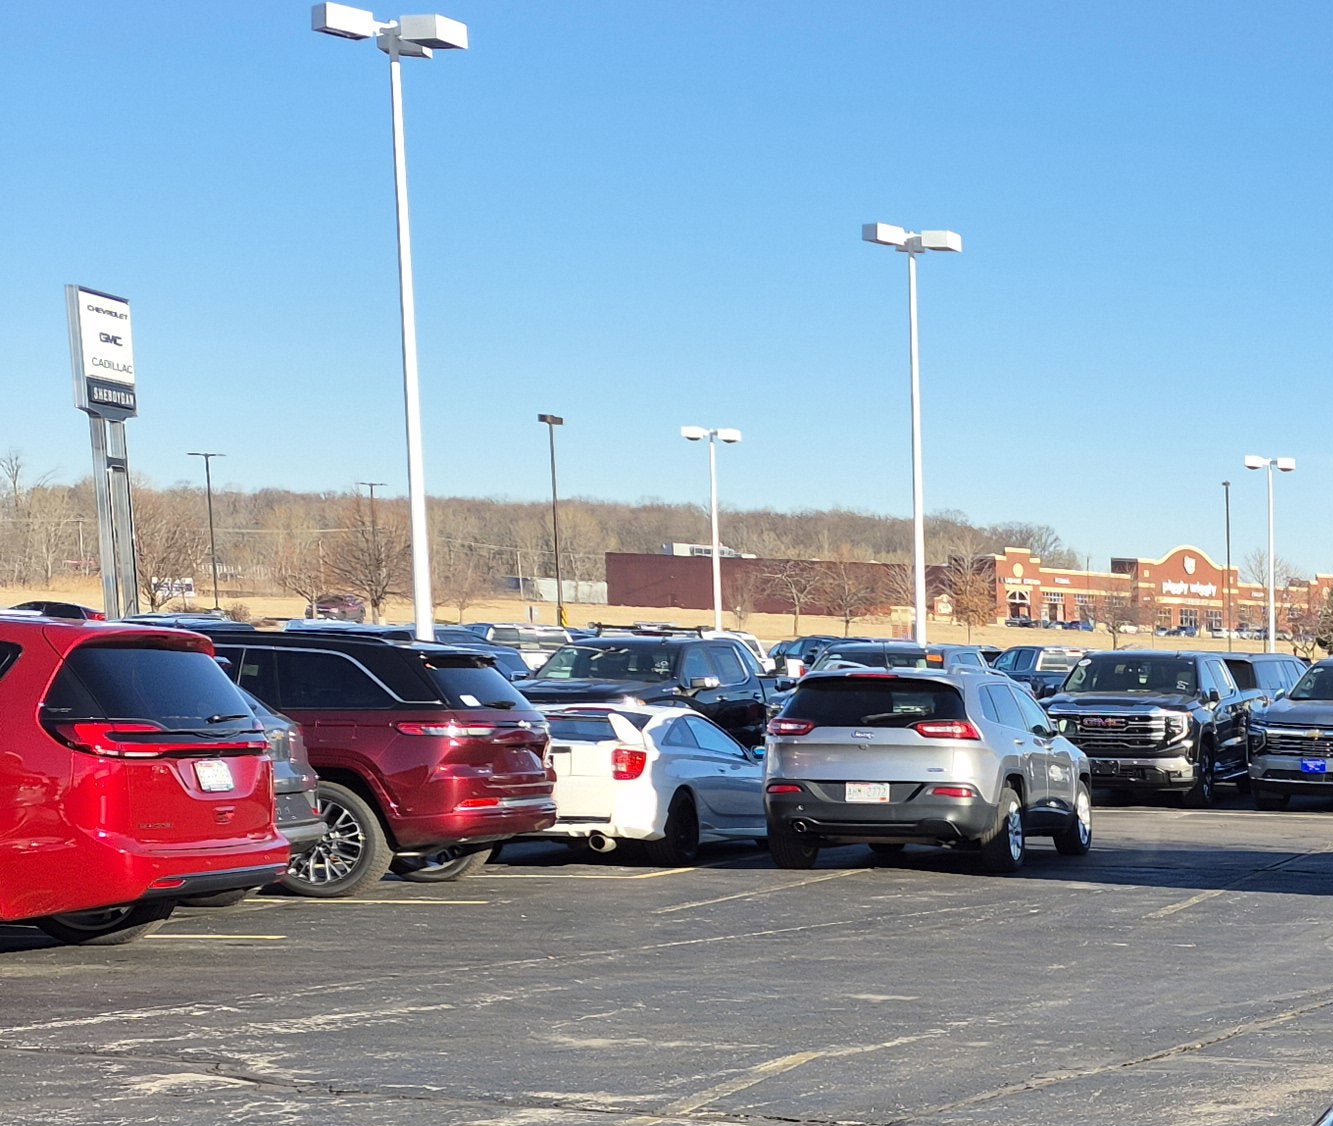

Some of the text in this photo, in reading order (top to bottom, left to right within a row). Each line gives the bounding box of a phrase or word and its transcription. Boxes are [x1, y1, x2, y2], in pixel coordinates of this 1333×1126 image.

[87, 304, 128, 320] CHEVROLET
[99, 332, 123, 347] GMC
[92, 357, 133, 374] CADILLAC
[93, 386, 134, 406] SHEBOYGAN
